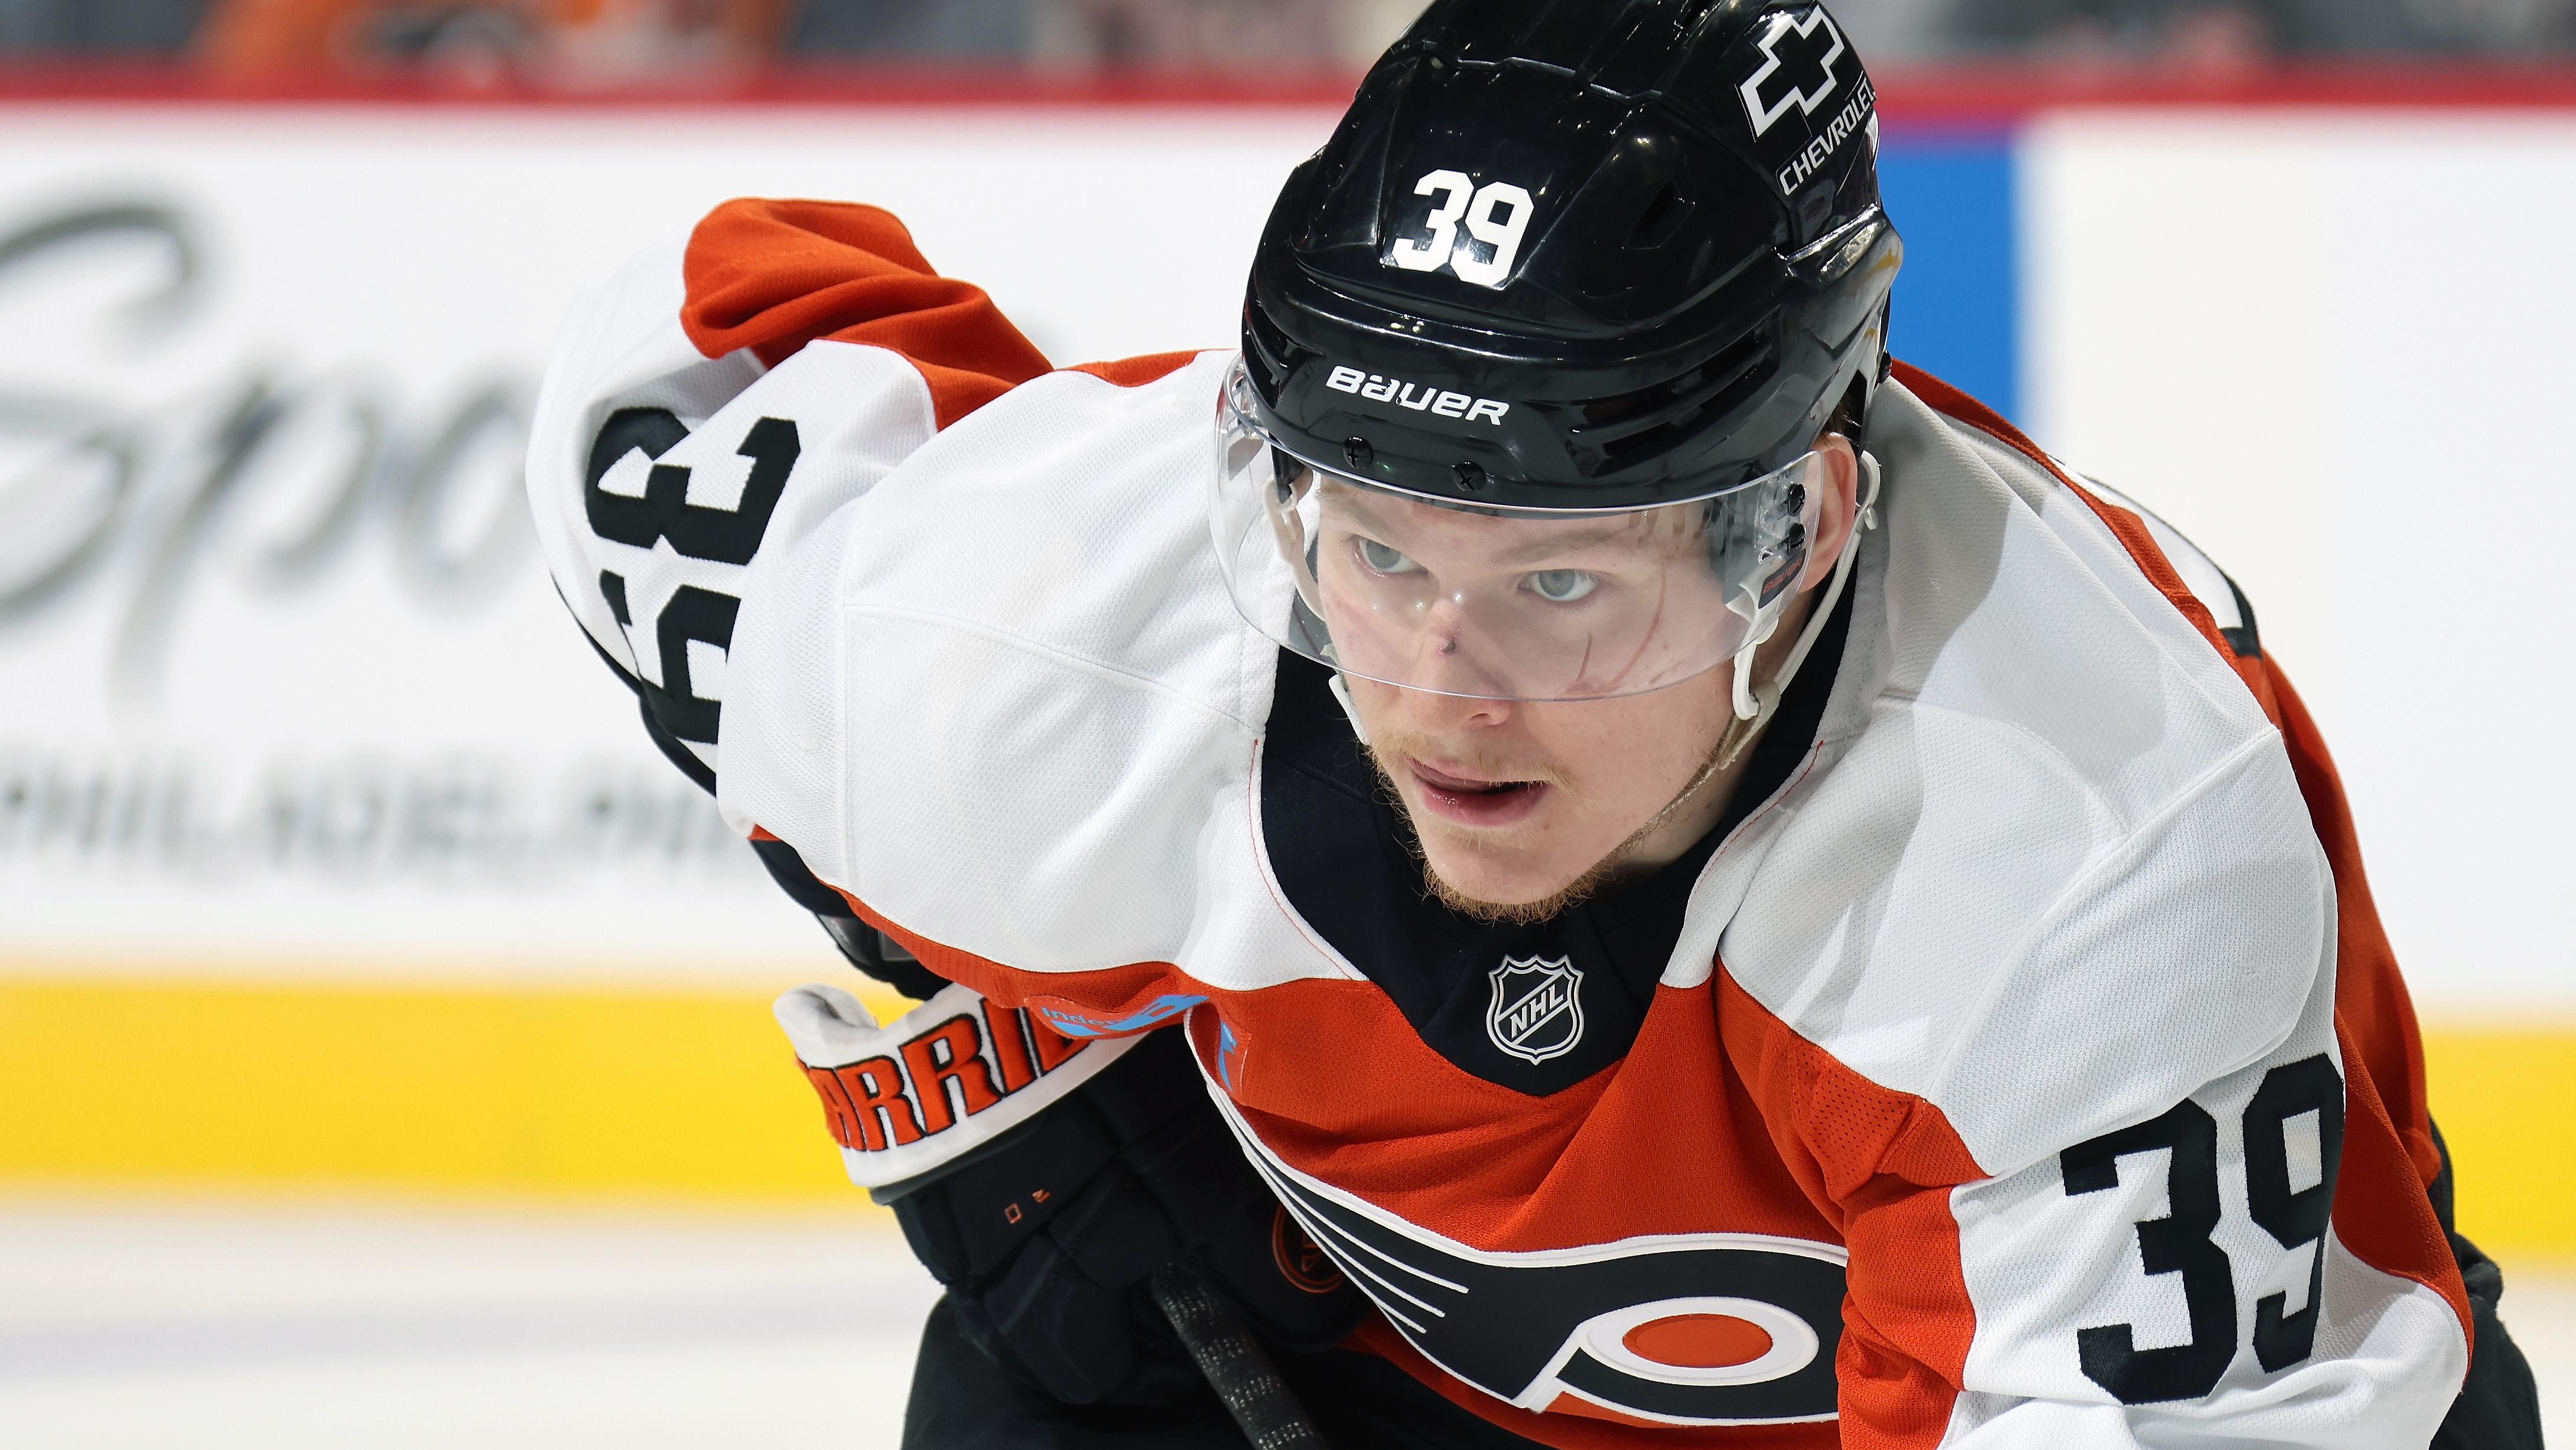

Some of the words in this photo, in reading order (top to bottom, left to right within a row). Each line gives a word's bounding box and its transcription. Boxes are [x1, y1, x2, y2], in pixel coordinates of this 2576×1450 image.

[1780, 77, 1875, 196] CHEVROLET
[1391, 169, 1535, 291] 39
[1509, 983, 1564, 1039] NHL
[2060, 1053, 2345, 1406] 39
